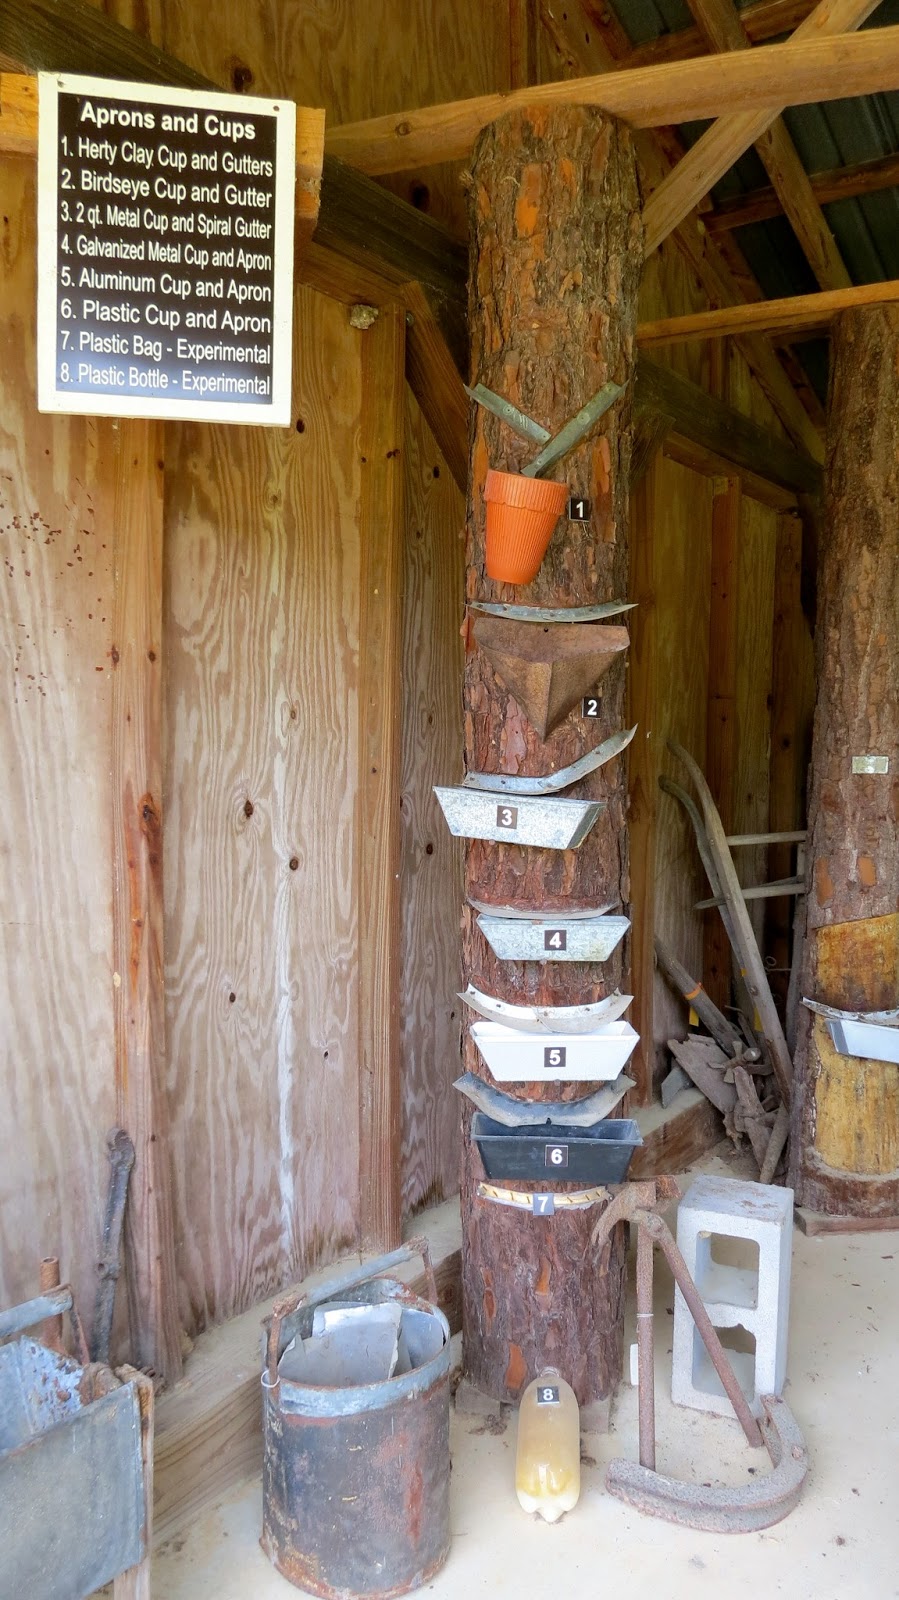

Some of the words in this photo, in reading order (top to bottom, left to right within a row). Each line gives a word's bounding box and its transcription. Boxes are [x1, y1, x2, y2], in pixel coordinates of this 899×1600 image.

[81, 102, 155, 130] Aprons
[162, 113, 198, 134] and
[204, 116, 256, 140] Cups
[61, 137, 73, 157] 1.
[78, 138, 117, 162] Herty
[121, 142, 154, 167] Clay
[158, 146, 187, 169] Cup
[191, 150, 217, 171] and
[222, 153, 273, 176] Gutters
[61, 170, 75, 190] 2.
[82, 171, 149, 200] Birdseye
[155, 178, 185, 202] Cup
[191, 182, 219, 203] and
[225, 185, 272, 208] Gutter
[61, 201, 72, 222] 3.
[76, 203, 85, 222] 2
[88, 207, 103, 229] qt.
[107, 208, 139, 229] Metal
[144, 210, 168, 233] Cup
[172, 213, 194, 233] and
[198, 216, 231, 238] Spiral
[235, 219, 271, 239] Gutter
[61, 235, 73, 254] 4.
[77, 235, 144, 260] Galvanized
[148, 241, 181, 262] Metal
[184, 244, 208, 267] Cup
[212, 247, 234, 267] and
[237, 251, 271, 273] Apron
[61, 268, 75, 287] 5.
[79, 268, 155, 292] Aluminum
[160, 275, 190, 298] Cup
[196, 278, 223, 298] and
[227, 281, 271, 303] Apron
[61, 299, 76, 318] 6.
[83, 300, 140, 322] Plastic
[145, 305, 180, 328] Cup
[186, 308, 216, 329] and
[221, 312, 270, 334] Apron
[61, 330, 74, 350] 7.
[79, 332, 128, 355] Plastic
[133, 336, 162, 360] Bag
[178, 340, 270, 366] Experimental
[61, 363, 73, 383] 8.
[78, 364, 125, 386] Plastic
[129, 368, 168, 389] Bottle
[183, 371, 270, 396] Experimental
[576, 501, 583, 518] 1
[588, 700, 597, 715] 2
[502, 809, 512, 825] 3
[549, 932, 561, 948] 4
[549, 1050, 560, 1065] 5
[551, 1149, 562, 1164] 6
[538, 1197, 548, 1212] 7
[543, 1389, 553, 1400] 8
